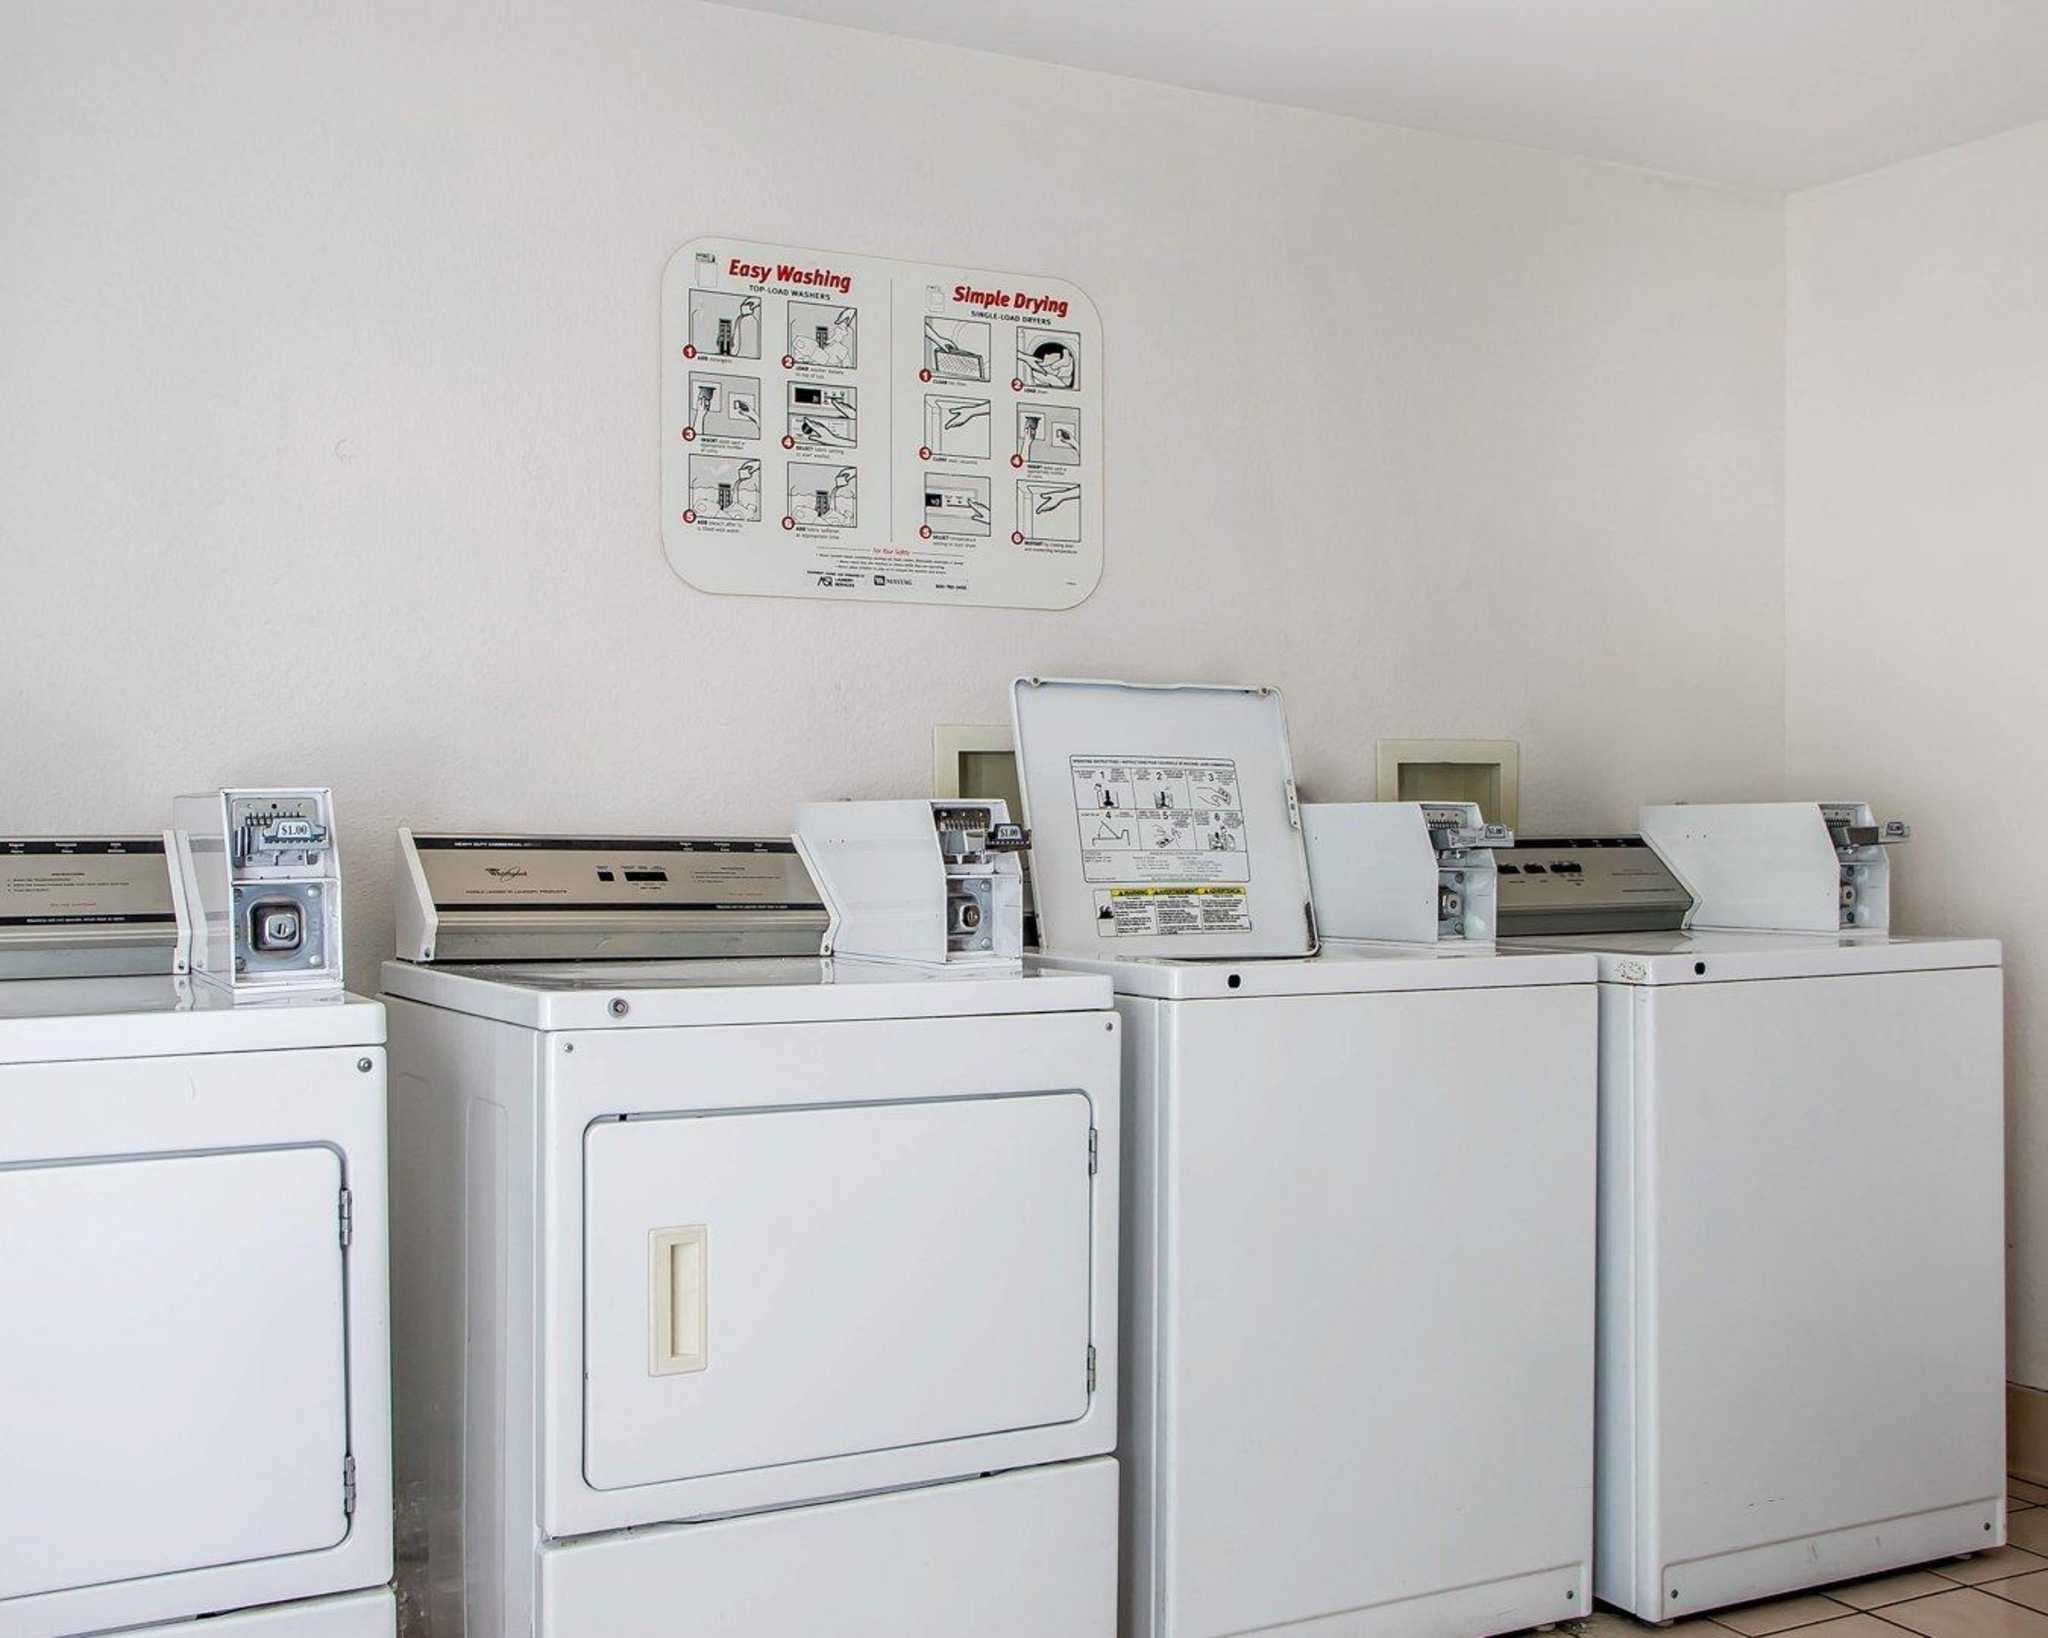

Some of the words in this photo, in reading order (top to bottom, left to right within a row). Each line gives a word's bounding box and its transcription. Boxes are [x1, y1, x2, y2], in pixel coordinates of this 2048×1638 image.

[728, 259, 772, 284] Easy
[776, 264, 852, 294] Washing
[749, 284, 790, 296] TOP-LOAD
[790, 290, 831, 301] WASHERS
[953, 286, 1010, 309] Simple
[1014, 292, 1069, 318] Drying
[970, 310, 1020, 322] SINGLE-LOAD
[1022, 315, 1052, 326] DRYERS
[1100, 770, 1106, 778] 1
[1156, 772, 1163, 780] 2
[1208, 773, 1215, 782] 3
[1105, 811, 1112, 819] 4
[1162, 811, 1169, 820] 5
[1214, 813, 1220, 822] 6
[281, 824, 308, 836] $1.00
[1000, 828, 1018, 839] $1.00
